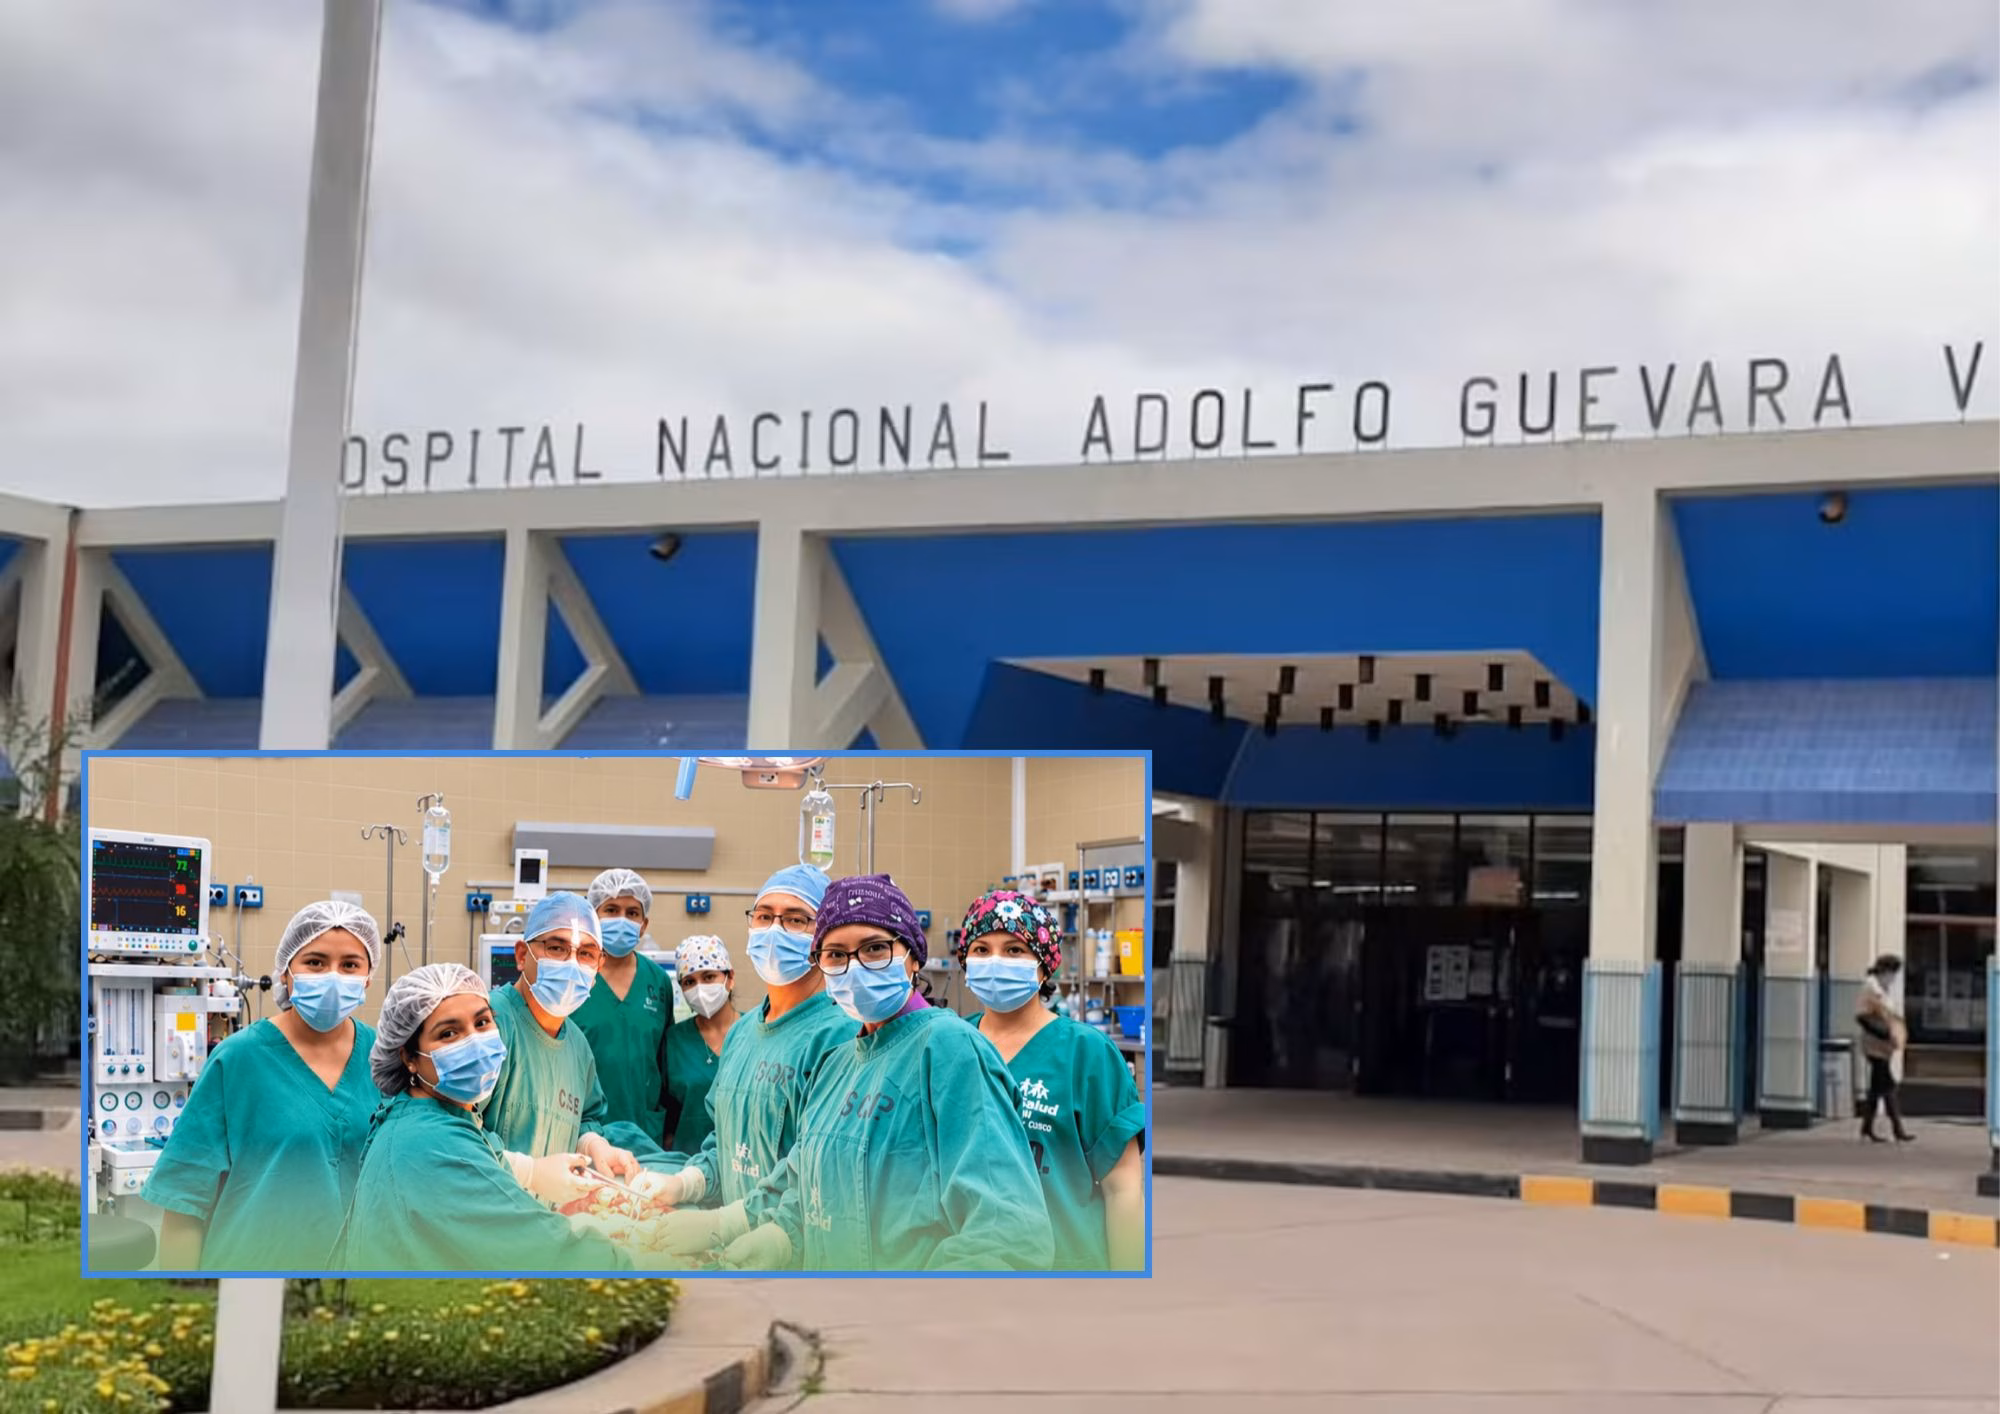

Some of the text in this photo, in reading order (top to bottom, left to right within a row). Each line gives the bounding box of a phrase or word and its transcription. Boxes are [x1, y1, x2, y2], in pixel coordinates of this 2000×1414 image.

[657, 401, 1011, 476] NACIONAL
[1081, 381, 1390, 456] ADOLFO
[1459, 354, 1852, 437] GUEVARA
[1944, 341, 1983, 412] V
[176, 905, 187, 916] 16
